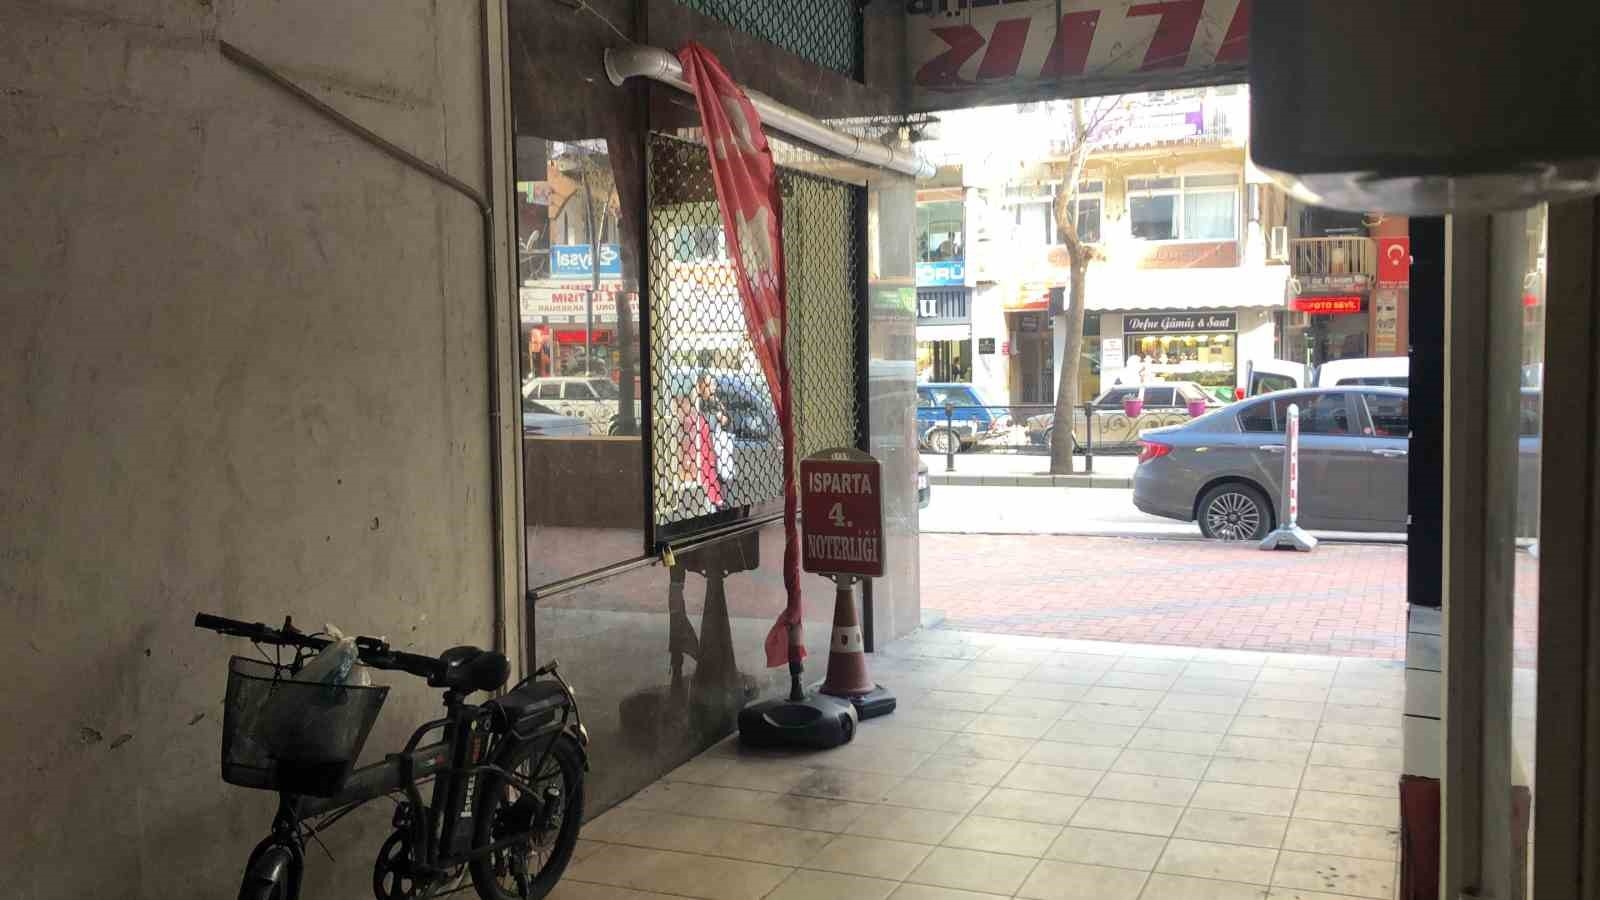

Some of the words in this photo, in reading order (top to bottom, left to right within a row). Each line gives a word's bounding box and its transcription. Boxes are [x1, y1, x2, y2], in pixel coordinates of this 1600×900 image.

[1129, 317, 1159, 331] Defne
[1161, 316, 1195, 331] Gümüş
[1198, 317, 1204, 328] &
[1206, 315, 1231, 328] Saat
[809, 471, 873, 495] ISPARTA
[828, 502, 853, 527] 4.
